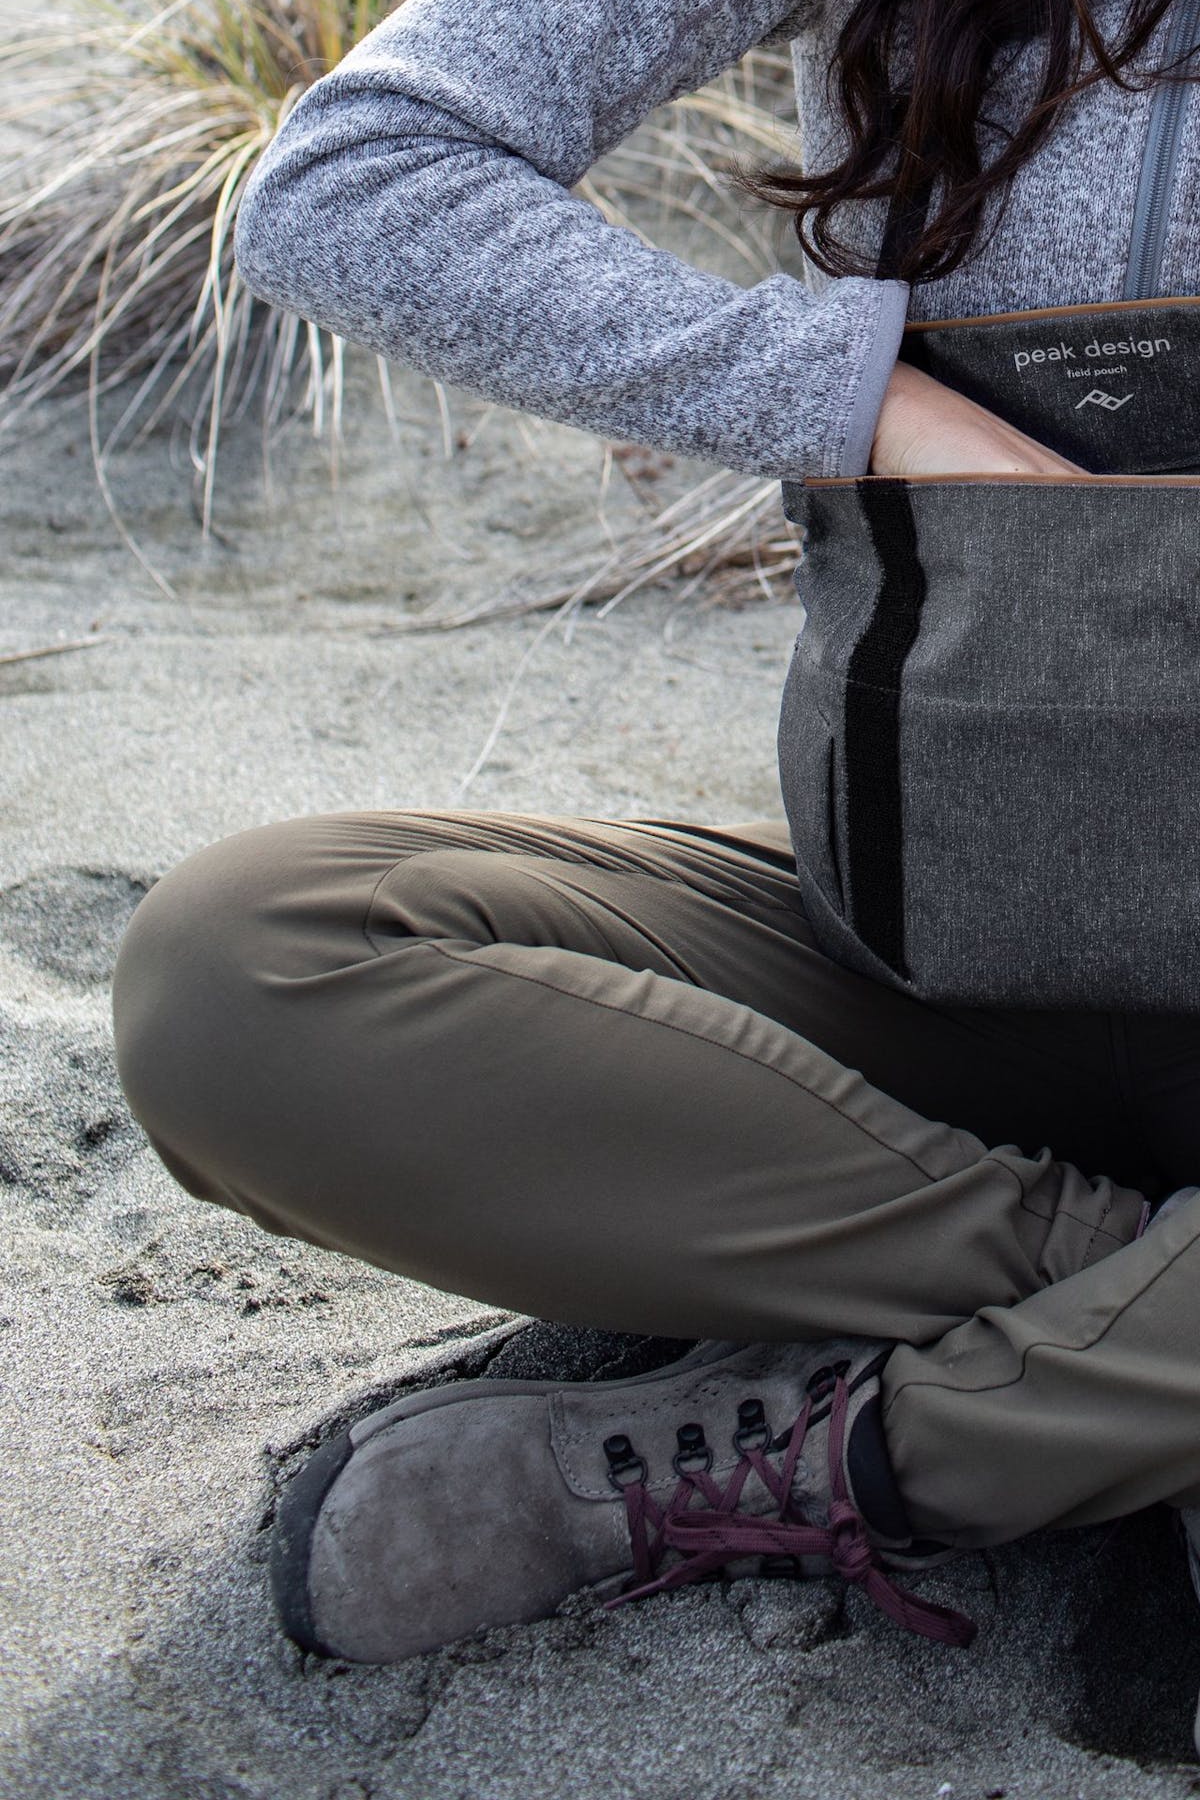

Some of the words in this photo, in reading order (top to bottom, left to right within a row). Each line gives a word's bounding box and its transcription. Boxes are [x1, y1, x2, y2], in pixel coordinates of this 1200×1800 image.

[1014, 342, 1076, 372] peak
[1085, 336, 1171, 358] design
[1066, 367, 1091, 378] field
[1094, 365, 1128, 377] pouch
